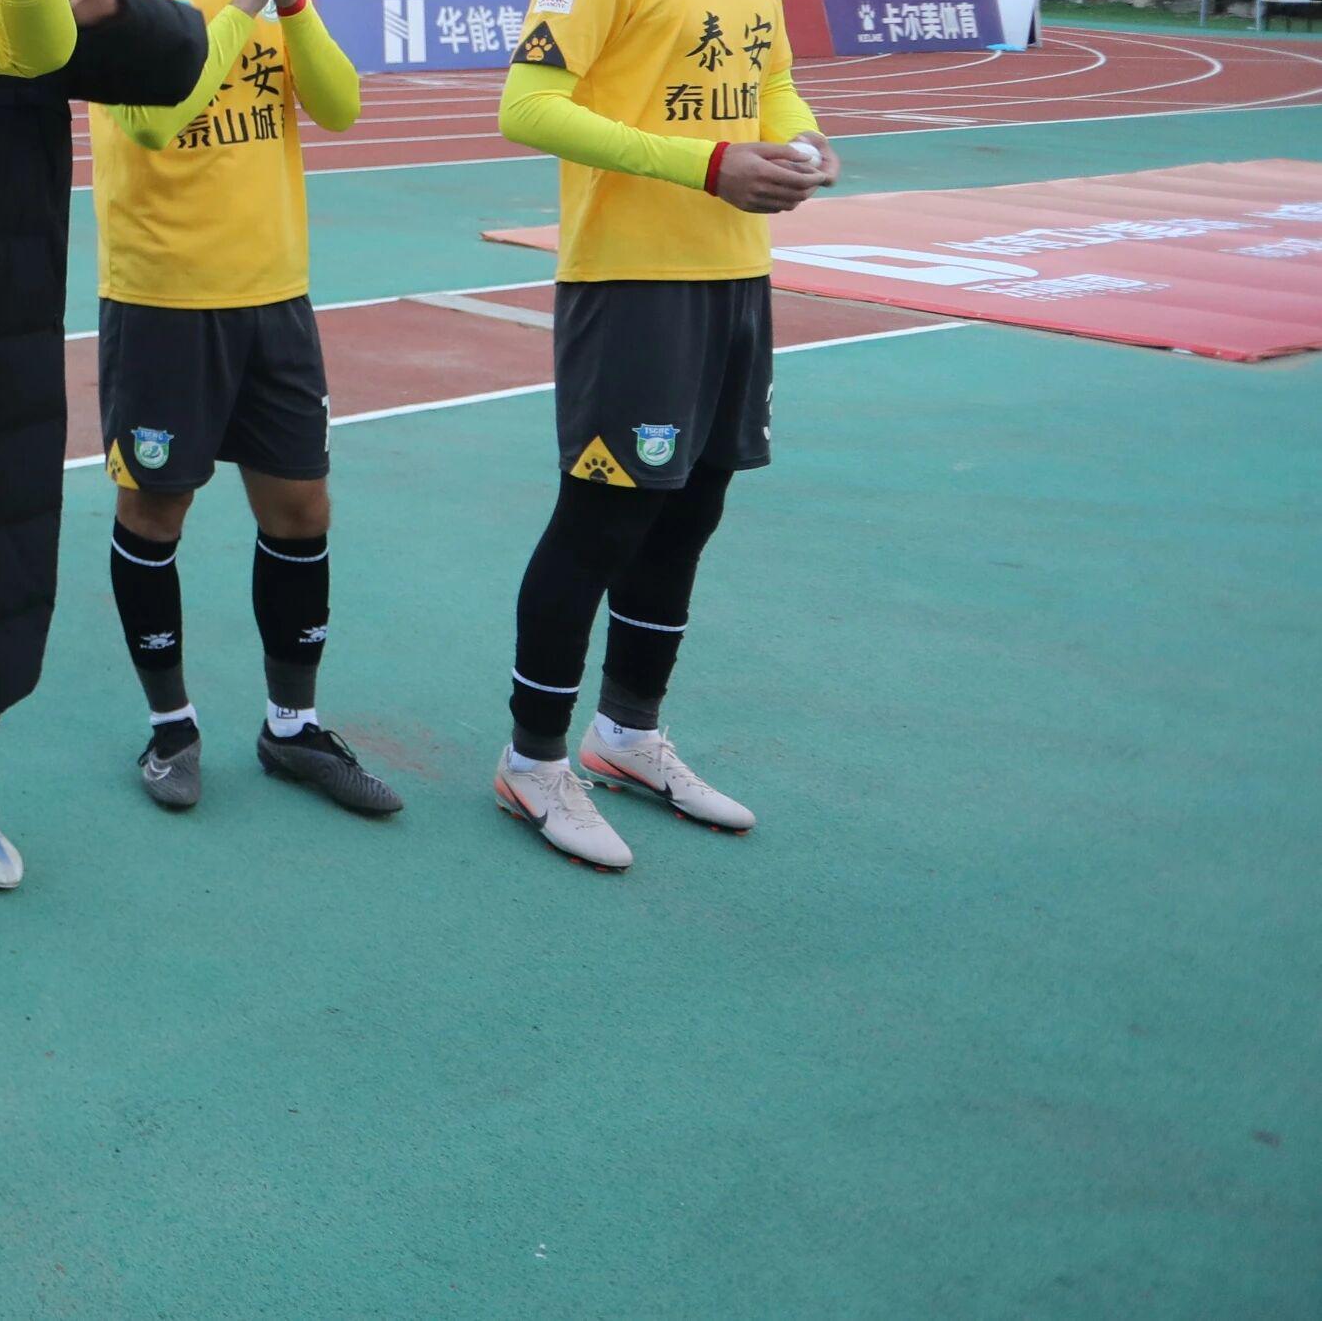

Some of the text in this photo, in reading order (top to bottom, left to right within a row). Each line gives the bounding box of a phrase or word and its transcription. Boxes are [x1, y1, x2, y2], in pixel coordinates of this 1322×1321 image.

[686, 11, 773, 72] 泰安
[882, 2, 979, 43] 卡尔美体育
[177, 103, 285, 149] 泰山城
